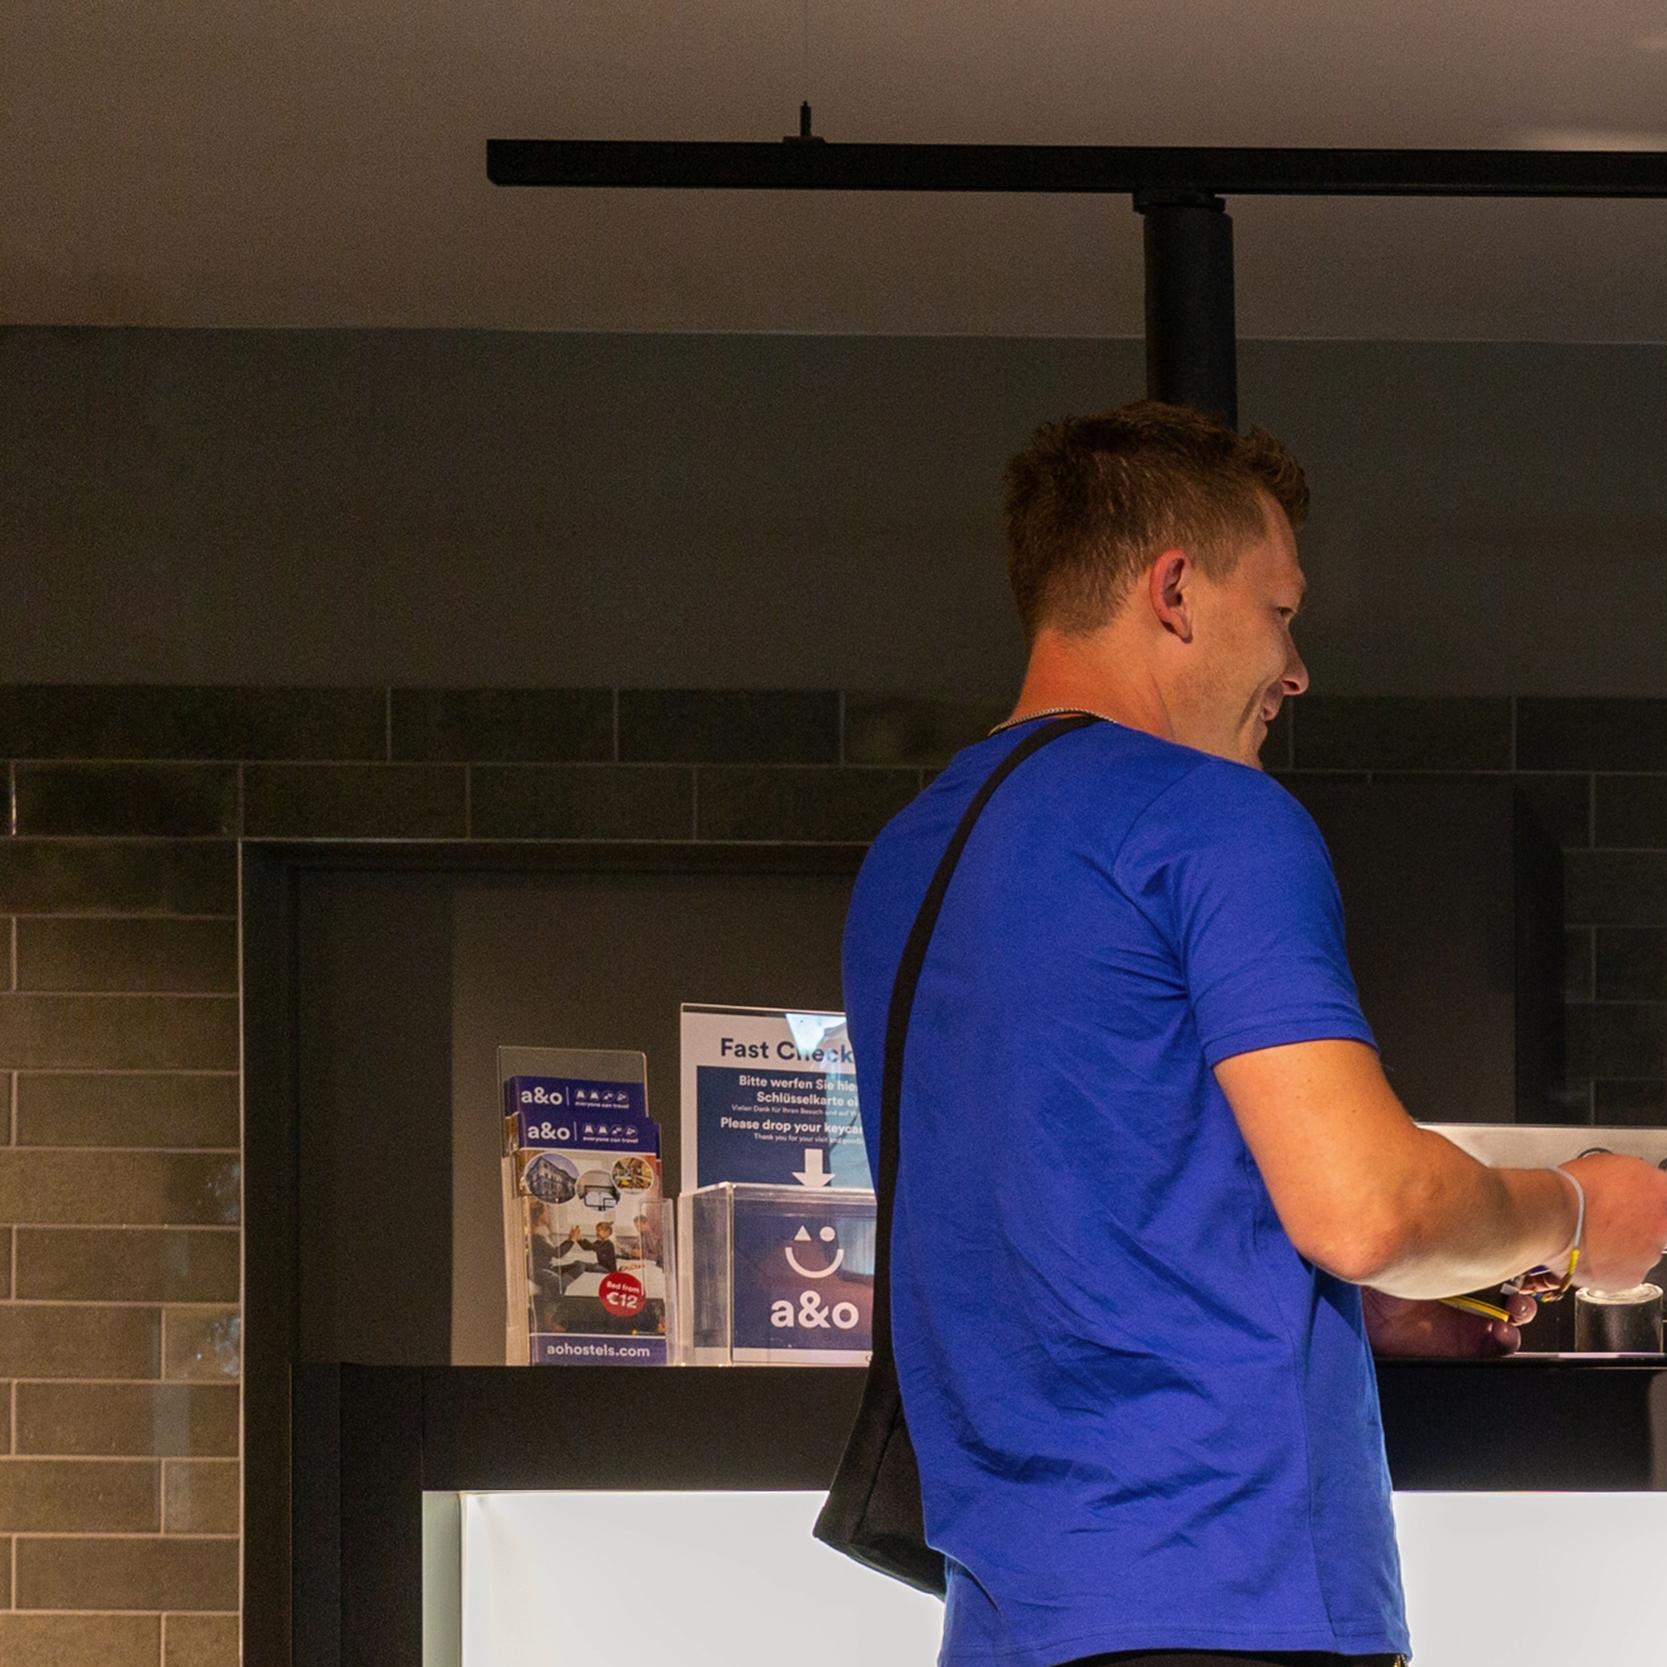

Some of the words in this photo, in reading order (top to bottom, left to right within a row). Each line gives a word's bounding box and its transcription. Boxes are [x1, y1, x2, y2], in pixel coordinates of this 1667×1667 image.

[721, 1037, 769, 1060] Fast
[739, 1075, 768, 1087] Bitte
[770, 1078, 813, 1090] werfen
[816, 1079, 834, 1090] Sie
[521, 1087, 563, 1105] a&o
[757, 1091, 844, 1106] Schlüsselkarte
[527, 1122, 570, 1140] a&o
[720, 1117, 760, 1130] Please
[762, 1119, 791, 1133] drop
[794, 1122, 822, 1135] your
[606, 1291, 638, 1309] €12
[770, 1290, 859, 1329] a&o
[547, 1343, 650, 1357] aohostels.com
